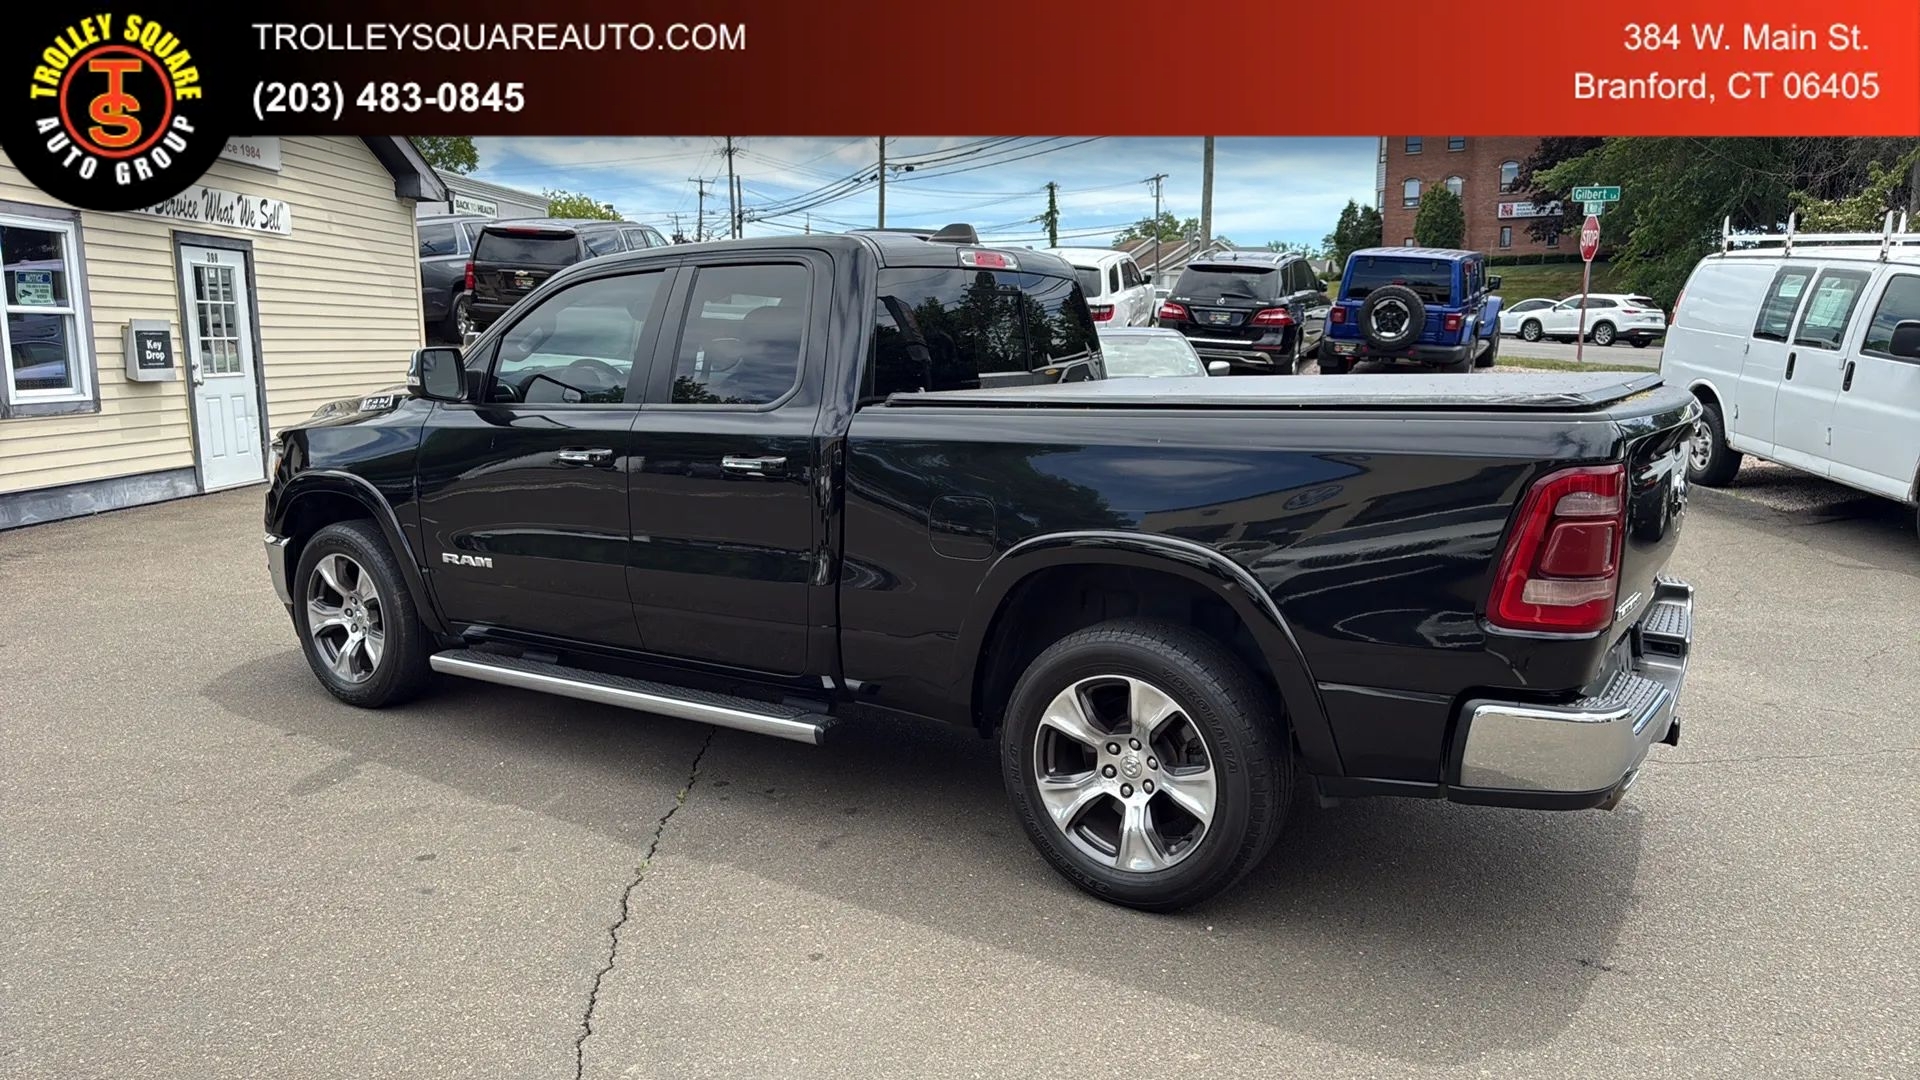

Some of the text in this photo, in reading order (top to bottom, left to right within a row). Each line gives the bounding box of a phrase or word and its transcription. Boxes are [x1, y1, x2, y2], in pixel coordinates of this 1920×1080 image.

[240, 143, 261, 159] 1984
[1575, 189, 1607, 200] Gilbert
[201, 188, 235, 224] What
[237, 193, 256, 228] We
[455, 199, 470, 210] BACK
[1581, 230, 1598, 247] STOP
[146, 340, 162, 350] Key
[146, 351, 165, 361] Drop
[442, 552, 493, 568] RAM
